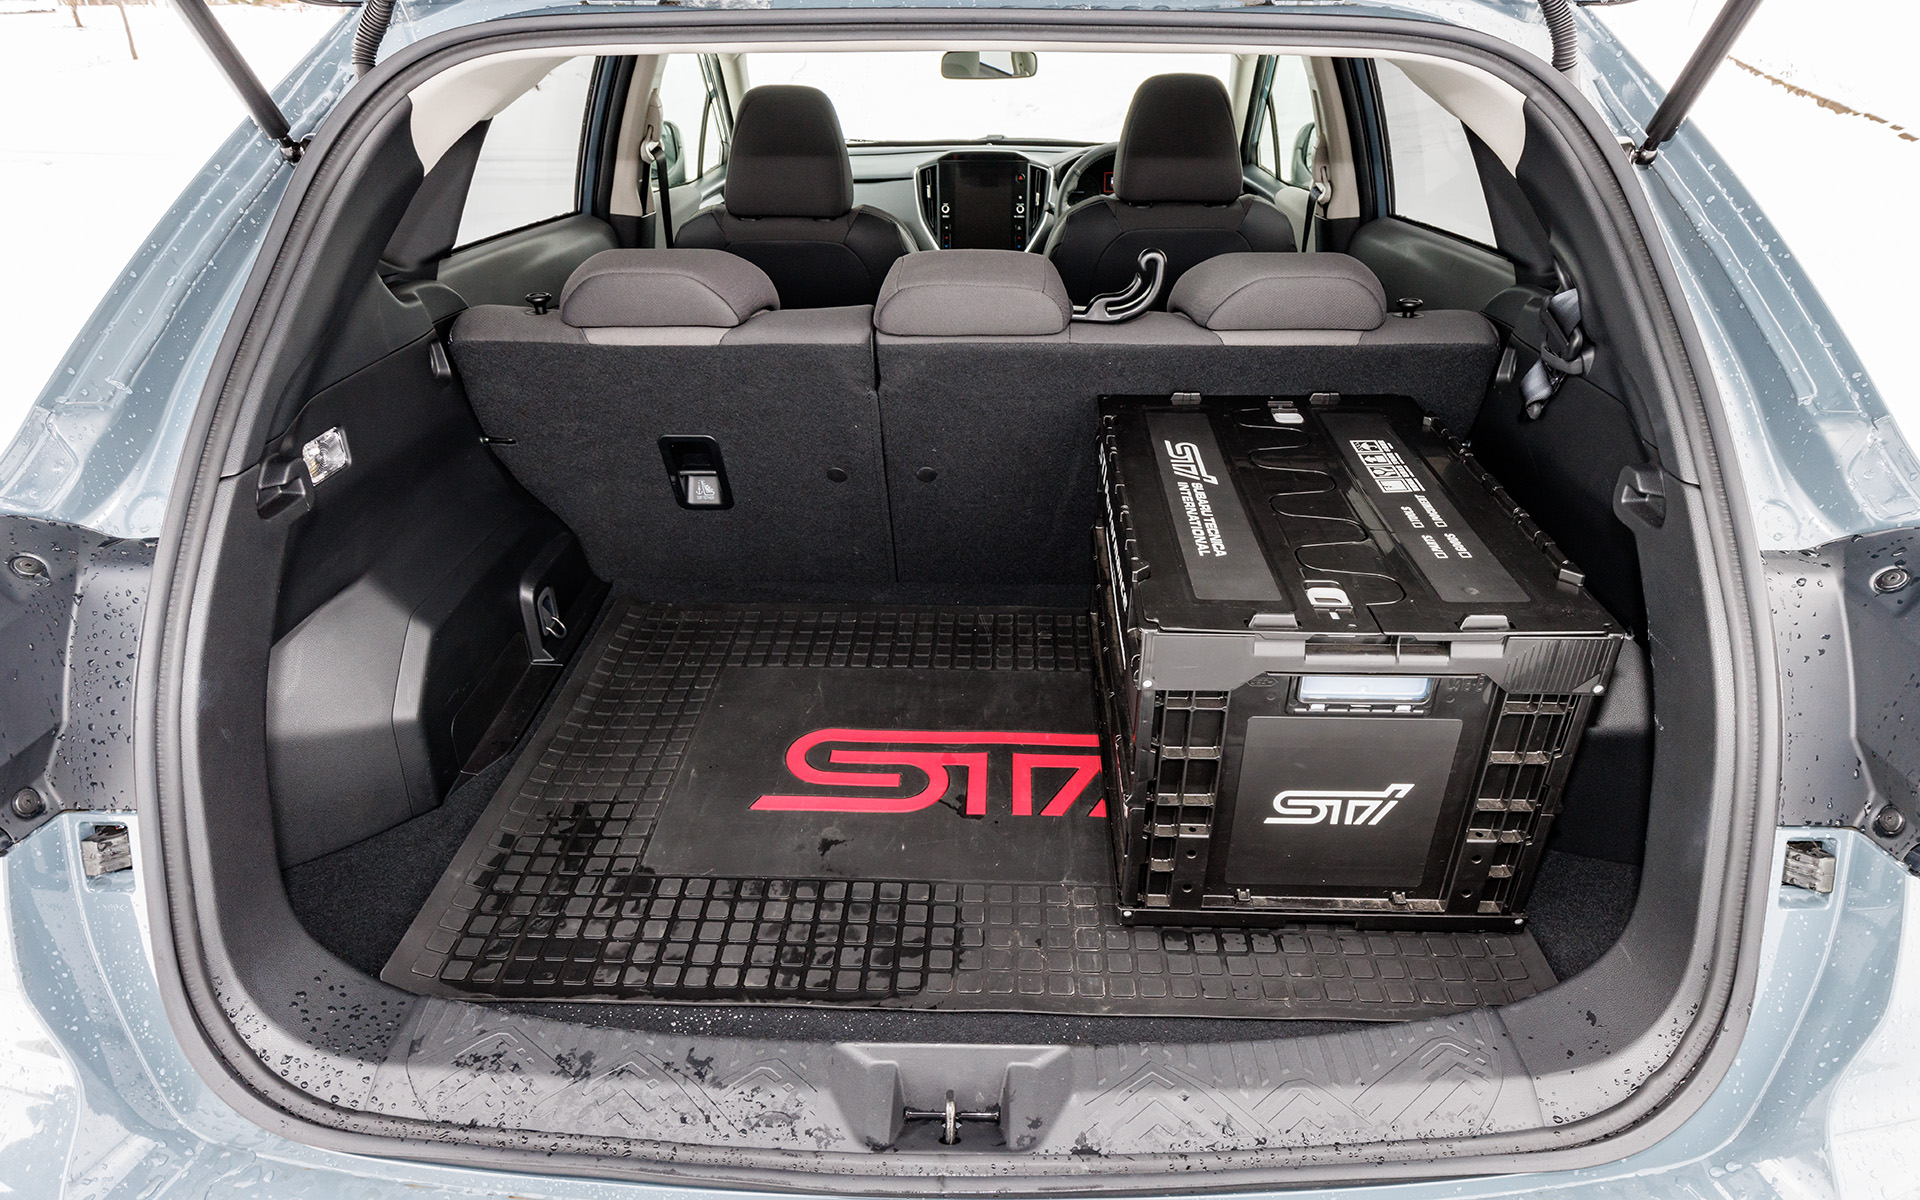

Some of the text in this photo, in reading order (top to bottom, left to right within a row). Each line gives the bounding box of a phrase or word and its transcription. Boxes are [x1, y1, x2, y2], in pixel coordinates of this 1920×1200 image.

[1177, 481, 1211, 557] INTERNATIONAL
[1191, 482, 1228, 557] SUBARU TECNICA
